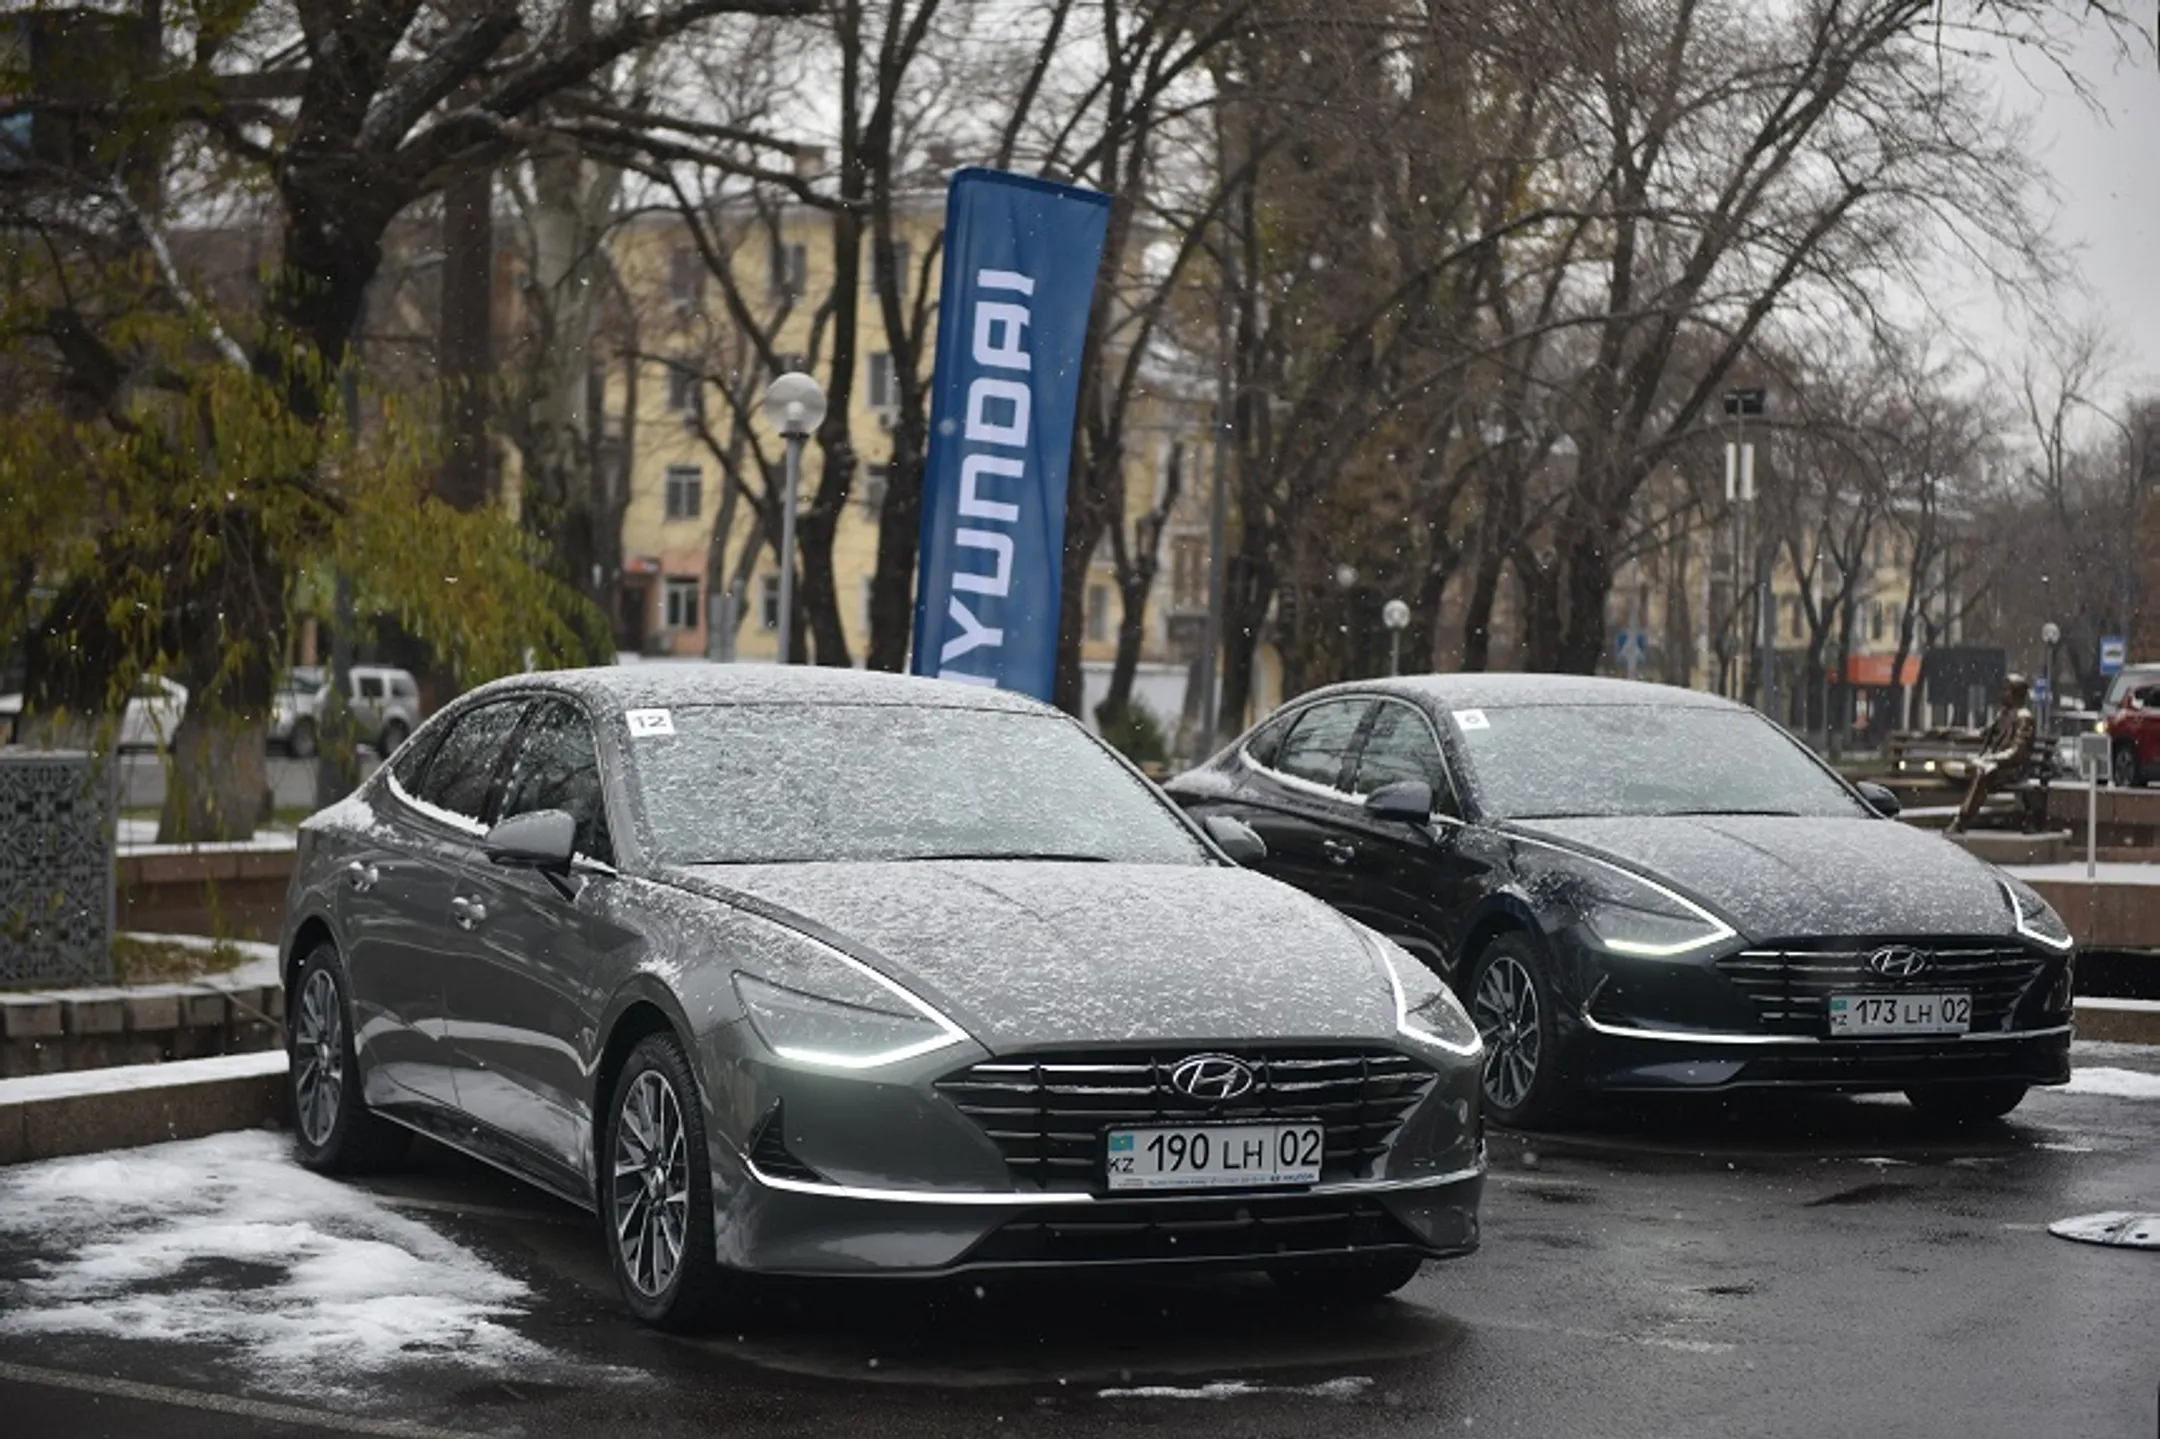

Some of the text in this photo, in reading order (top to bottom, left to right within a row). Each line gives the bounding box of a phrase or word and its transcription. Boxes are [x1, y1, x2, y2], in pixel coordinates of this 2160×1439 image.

[635, 715, 667, 729] 12
[1855, 997, 1970, 1024] 173 LH 02
[1147, 1128, 1320, 1172] 190 LH 02
[1107, 1157, 1134, 1173] KZ
